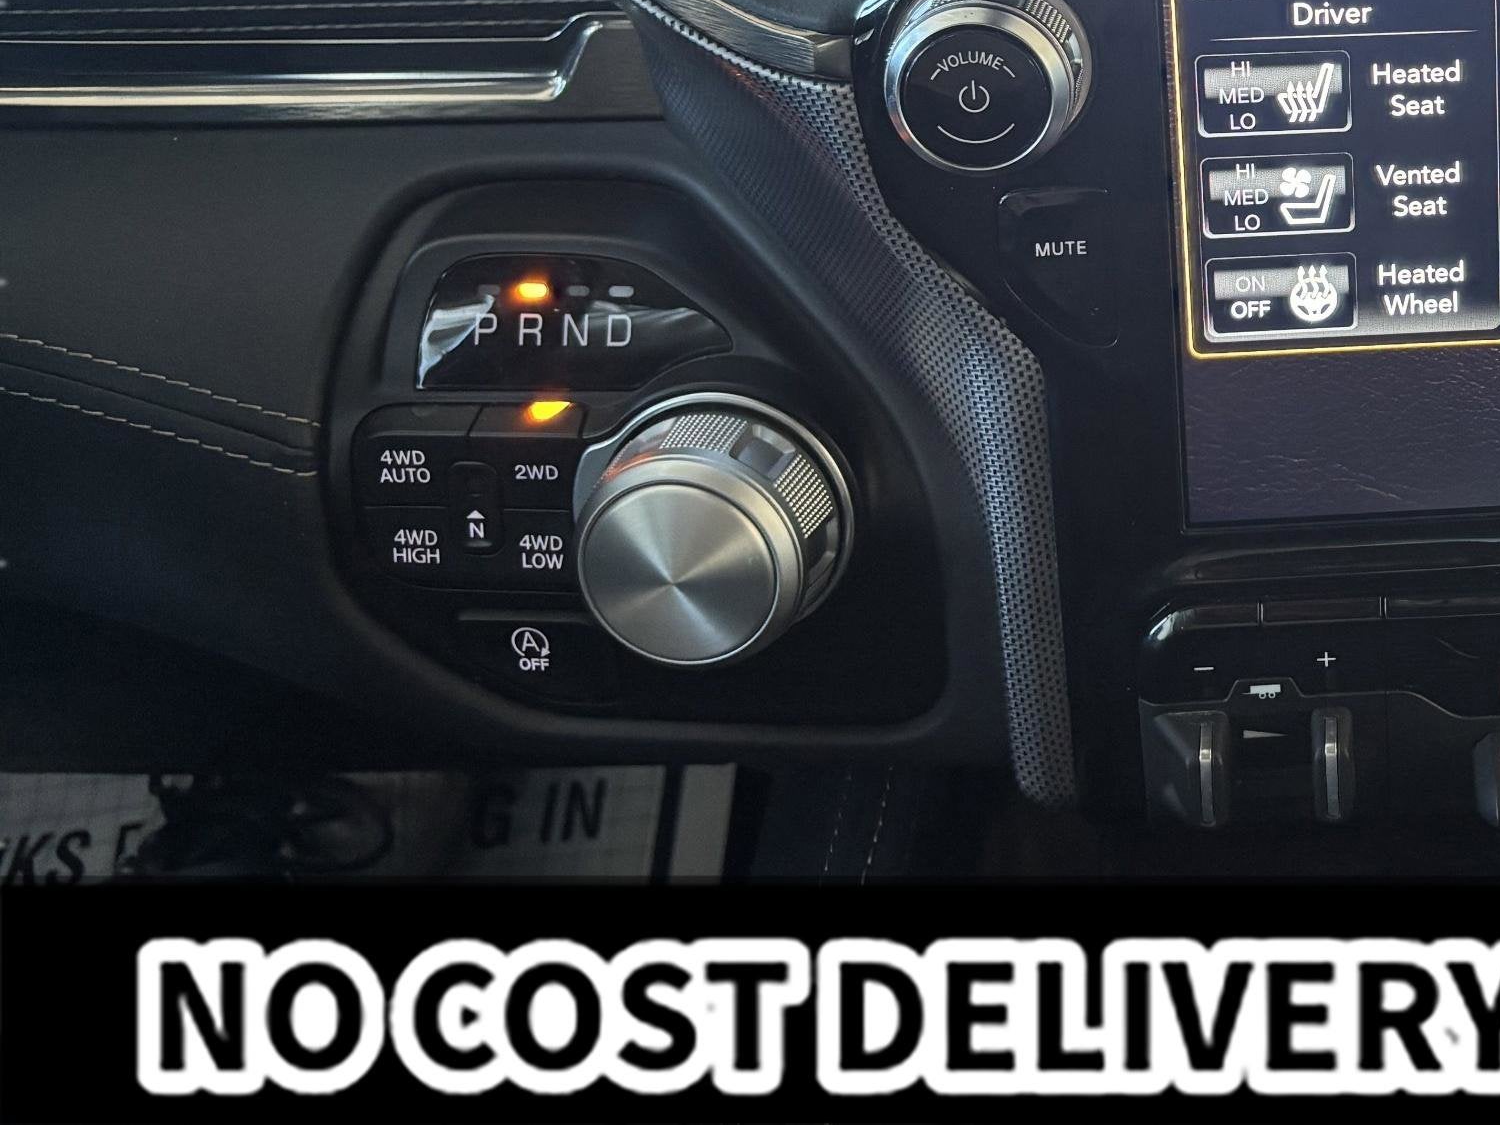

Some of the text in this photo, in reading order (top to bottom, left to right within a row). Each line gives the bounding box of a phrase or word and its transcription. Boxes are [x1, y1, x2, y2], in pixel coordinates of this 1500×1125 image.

[1293, 2, 1372, 26] Driver
[937, 51, 1004, 72] VOLUME
[1231, 62, 1251, 78] HI
[1372, 59, 1461, 85] Heated
[1219, 88, 1264, 104] MED
[1391, 93, 1445, 116] Seat
[1230, 113, 1256, 130] LO
[1235, 163, 1255, 180] HI
[1376, 161, 1461, 186] Vented
[1224, 189, 1268, 205] MED
[1393, 195, 1447, 217] Seat
[1235, 214, 1260, 232] LO
[1035, 241, 1087, 257] MUTE
[1377, 260, 1465, 286] Heated
[1235, 276, 1265, 292] ON
[1230, 300, 1271, 319] OFF
[1384, 292, 1459, 316] Wheel
[380, 450, 425, 465] 4WD
[380, 467, 430, 484] AUTO
[514, 465, 559, 481] 2WD
[393, 530, 438, 546] 4WD
[469, 523, 484, 538] N
[519, 535, 563, 551] 4WD
[392, 548, 440, 564] HIGH
[521, 553, 563, 569] LOW
[519, 658, 549, 671] OFF
[0, 830, 91, 885] KS
